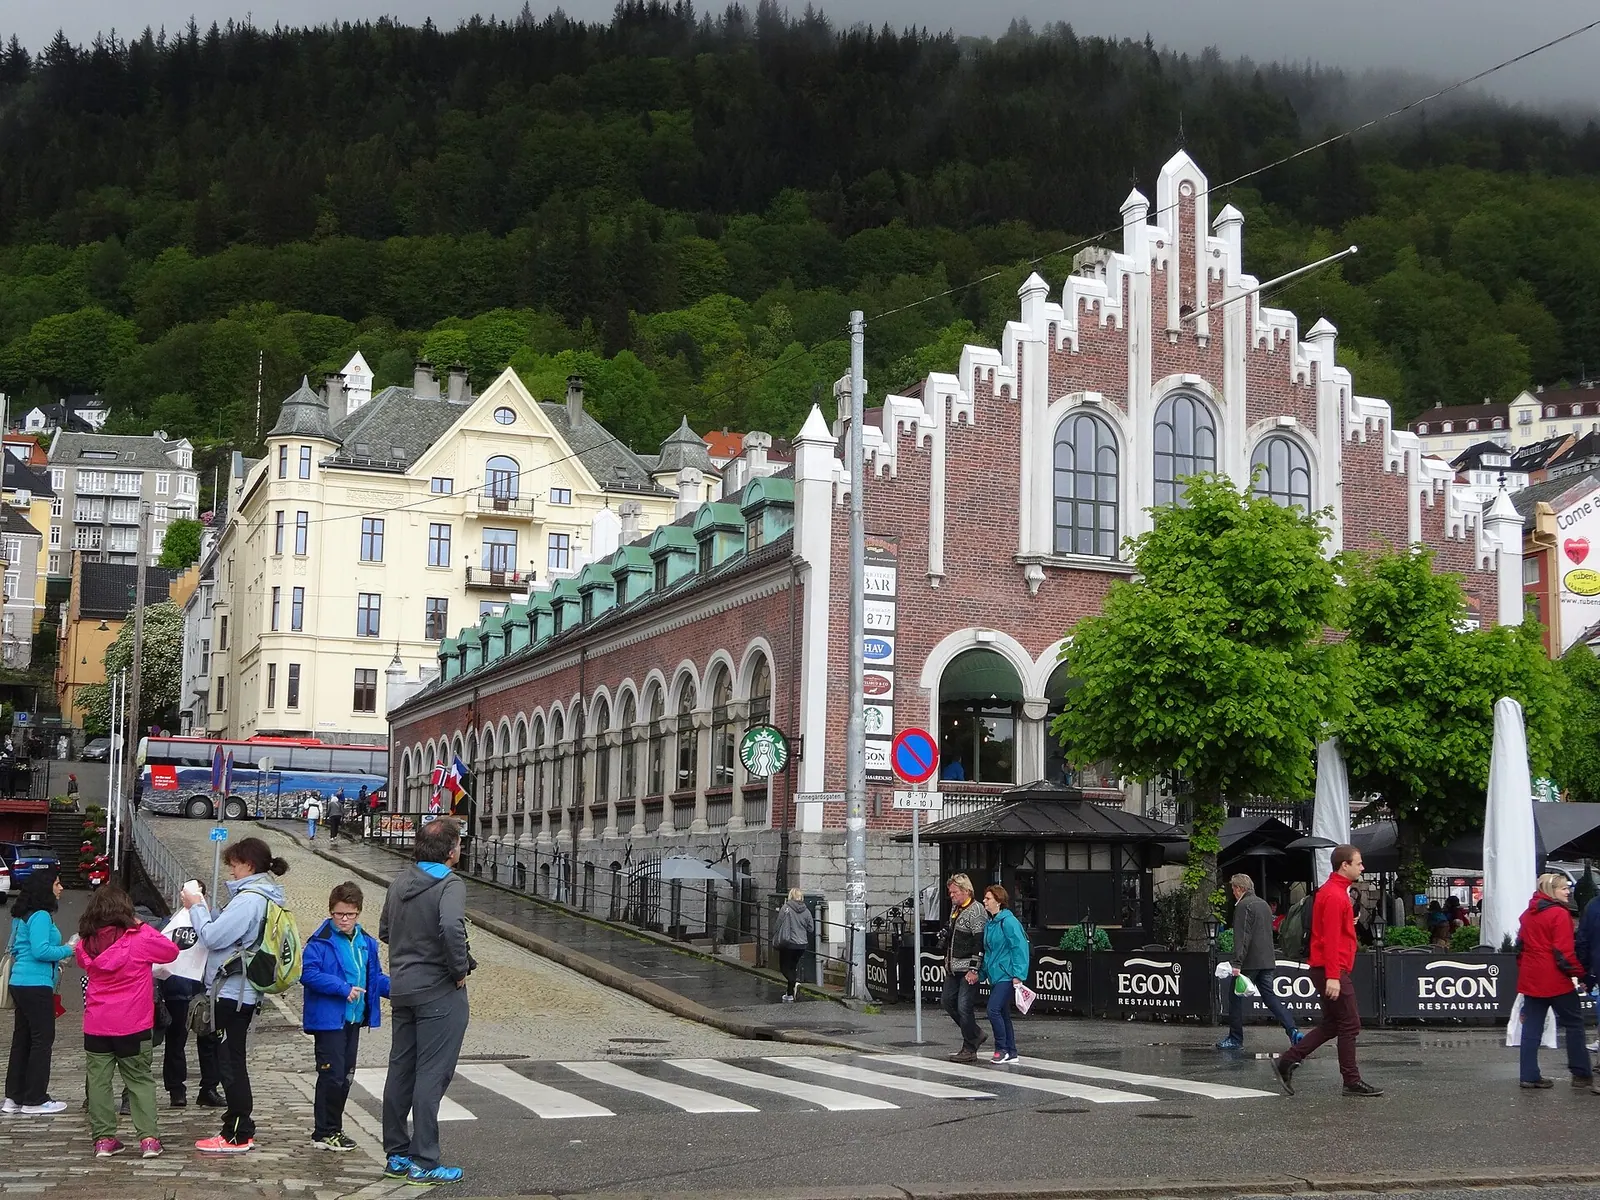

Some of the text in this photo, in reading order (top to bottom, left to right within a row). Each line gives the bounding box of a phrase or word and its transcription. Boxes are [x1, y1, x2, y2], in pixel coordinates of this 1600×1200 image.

[1556, 503, 1592, 530] Come
[866, 613, 891, 625] 877
[864, 643, 884, 653] HAV
[864, 752, 885, 761] GON
[867, 964, 887, 984] EGON
[914, 965, 946, 983] GON
[1035, 970, 1072, 991] EGON
[1117, 973, 1180, 995] EGON
[1268, 976, 1320, 997] GO
[1417, 976, 1498, 998] EGON
[1036, 993, 1073, 1002] RESTAURANT
[1118, 997, 1181, 1007] RESTAURANT
[1418, 1002, 1500, 1010] RESTAURANT
